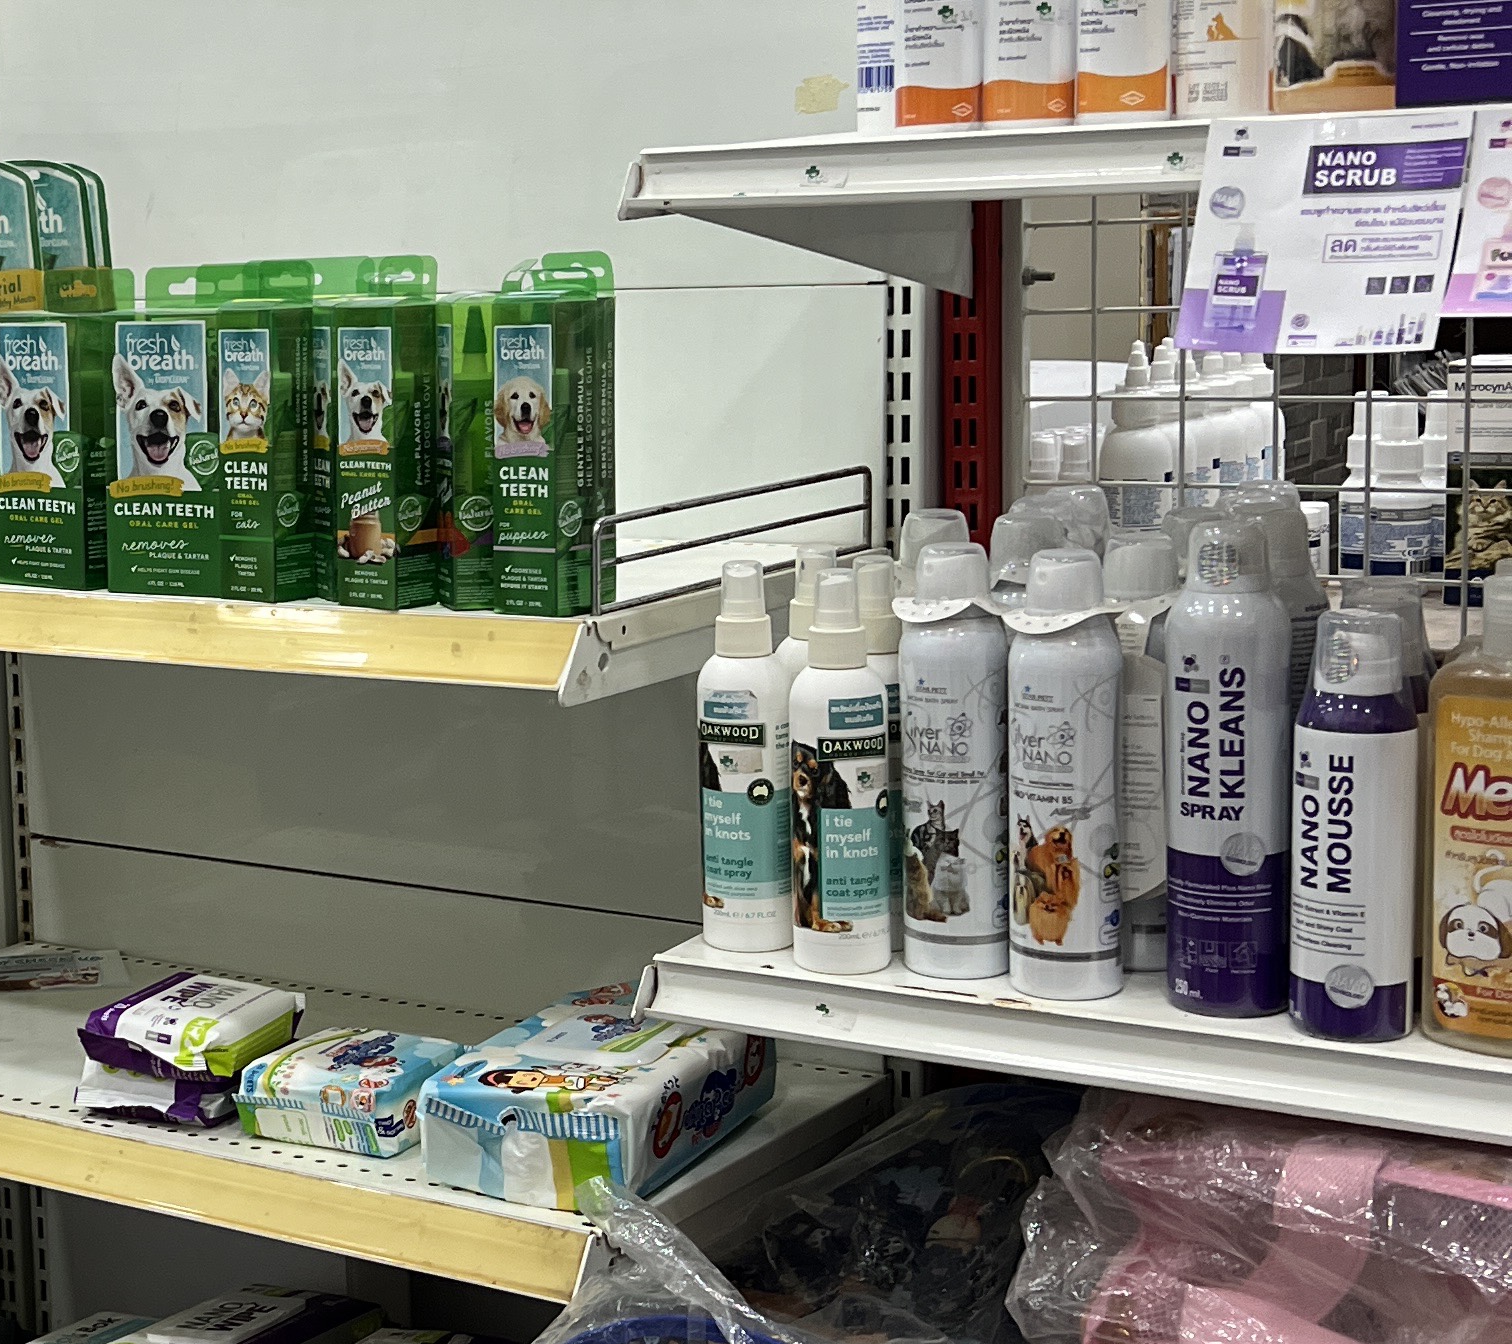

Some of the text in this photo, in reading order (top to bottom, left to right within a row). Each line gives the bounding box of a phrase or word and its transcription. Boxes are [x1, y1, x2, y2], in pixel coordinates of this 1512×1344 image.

[1316, 150, 1377, 167] NANO
[1314, 168, 1397, 188] SCRUB
[1330, 238, 1357, 253] ลด
[1217, 285, 1247, 294] SCRUB
[4, 334, 37, 355] fresh
[126, 333, 168, 355] fresh
[224, 336, 248, 351] fresh
[343, 335, 370, 350] fresh
[500, 333, 528, 350] fresh
[6, 350, 58, 371] breath
[127, 349, 195, 371] breath
[225, 347, 264, 362] breath
[343, 347, 385, 362] breath
[501, 345, 545, 361] breath
[224, 461, 268, 475] CLEAN
[340, 461, 392, 471] CLEAN TEETH
[500, 466, 549, 481] CLEAN
[116, 483, 130, 493] No
[225, 477, 268, 491] TEETH
[500, 484, 549, 498] TEETH
[341, 481, 383, 509] Peanut
[37, 498, 75, 514] TEETH
[114, 503, 215, 519] CLEAN TEETH
[350, 495, 391, 520] Butter
[129, 520, 199, 529] ORAL CARE GEL
[236, 518, 260, 529] cats
[498, 530, 550, 544] puppies
[122, 539, 189, 551] removes
[701, 723, 759, 739] OAKWOOD
[1219, 666, 1246, 799] KLEANS
[822, 738, 884, 754] OAKWOOD
[920, 741, 969, 756] NANO
[1188, 701, 1210, 798] NANO
[1023, 750, 1073, 765] NANO
[1180, 802, 1245, 821] SPRAY
[704, 812, 741, 827] myself
[834, 815, 852, 827] tie
[1327, 754, 1354, 894] MOUSSE
[715, 826, 751, 841] knots
[825, 829, 871, 845] myself
[1300, 794, 1320, 890] NANO
[825, 844, 879, 859] in knots
[721, 856, 754, 870] tangle
[724, 867, 752, 881] spray
[826, 873, 880, 888] anti tangle
[826, 887, 879, 900] coat spray
[174, 1300, 244, 1330] NANO
[206, 1301, 279, 1333] WIPE
